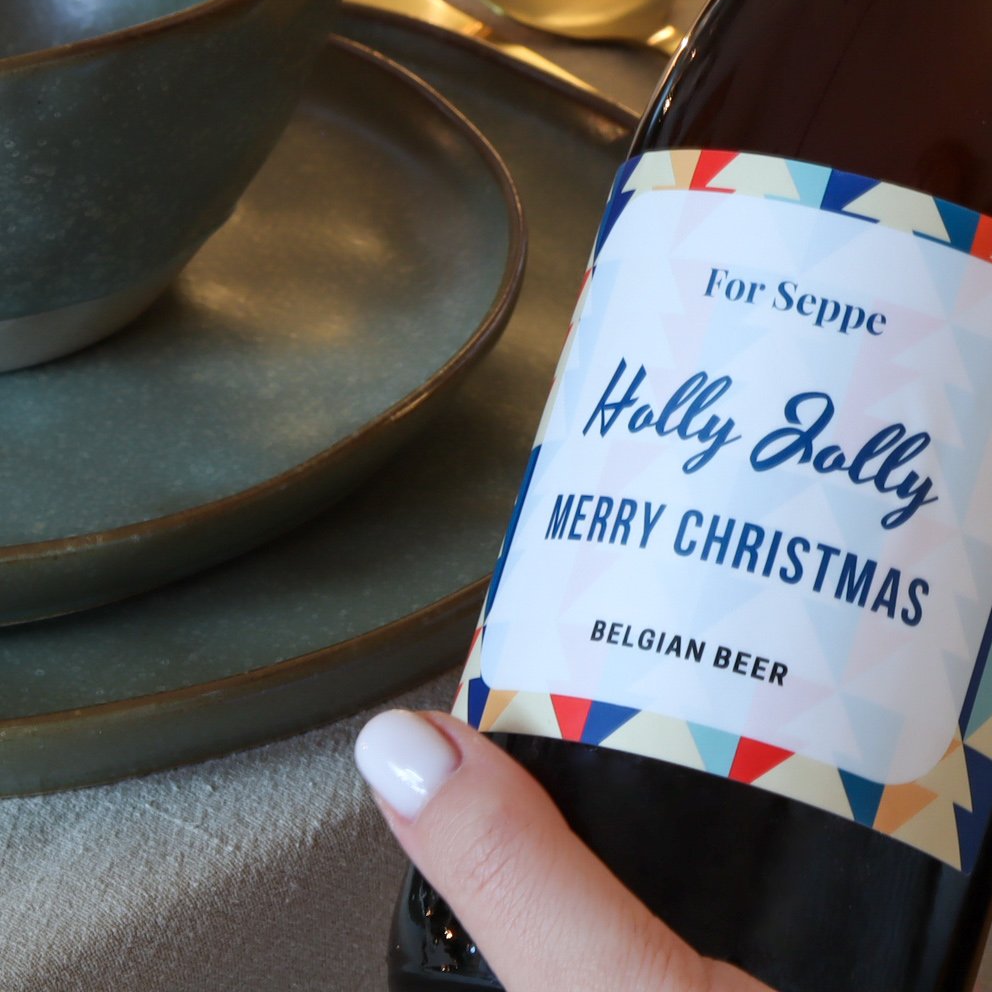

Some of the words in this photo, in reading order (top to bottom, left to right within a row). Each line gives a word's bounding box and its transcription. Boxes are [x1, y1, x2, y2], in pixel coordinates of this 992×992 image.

[703, 268, 766, 304] For
[771, 280, 888, 336] Seppe
[582, 356, 742, 475] Holly
[749, 391, 939, 530] Jolly
[544, 494, 667, 549] MERRY
[672, 509, 930, 627] CHRISTMAS
[590, 619, 706, 663] BELGIAN
[712, 645, 789, 687] BEER
